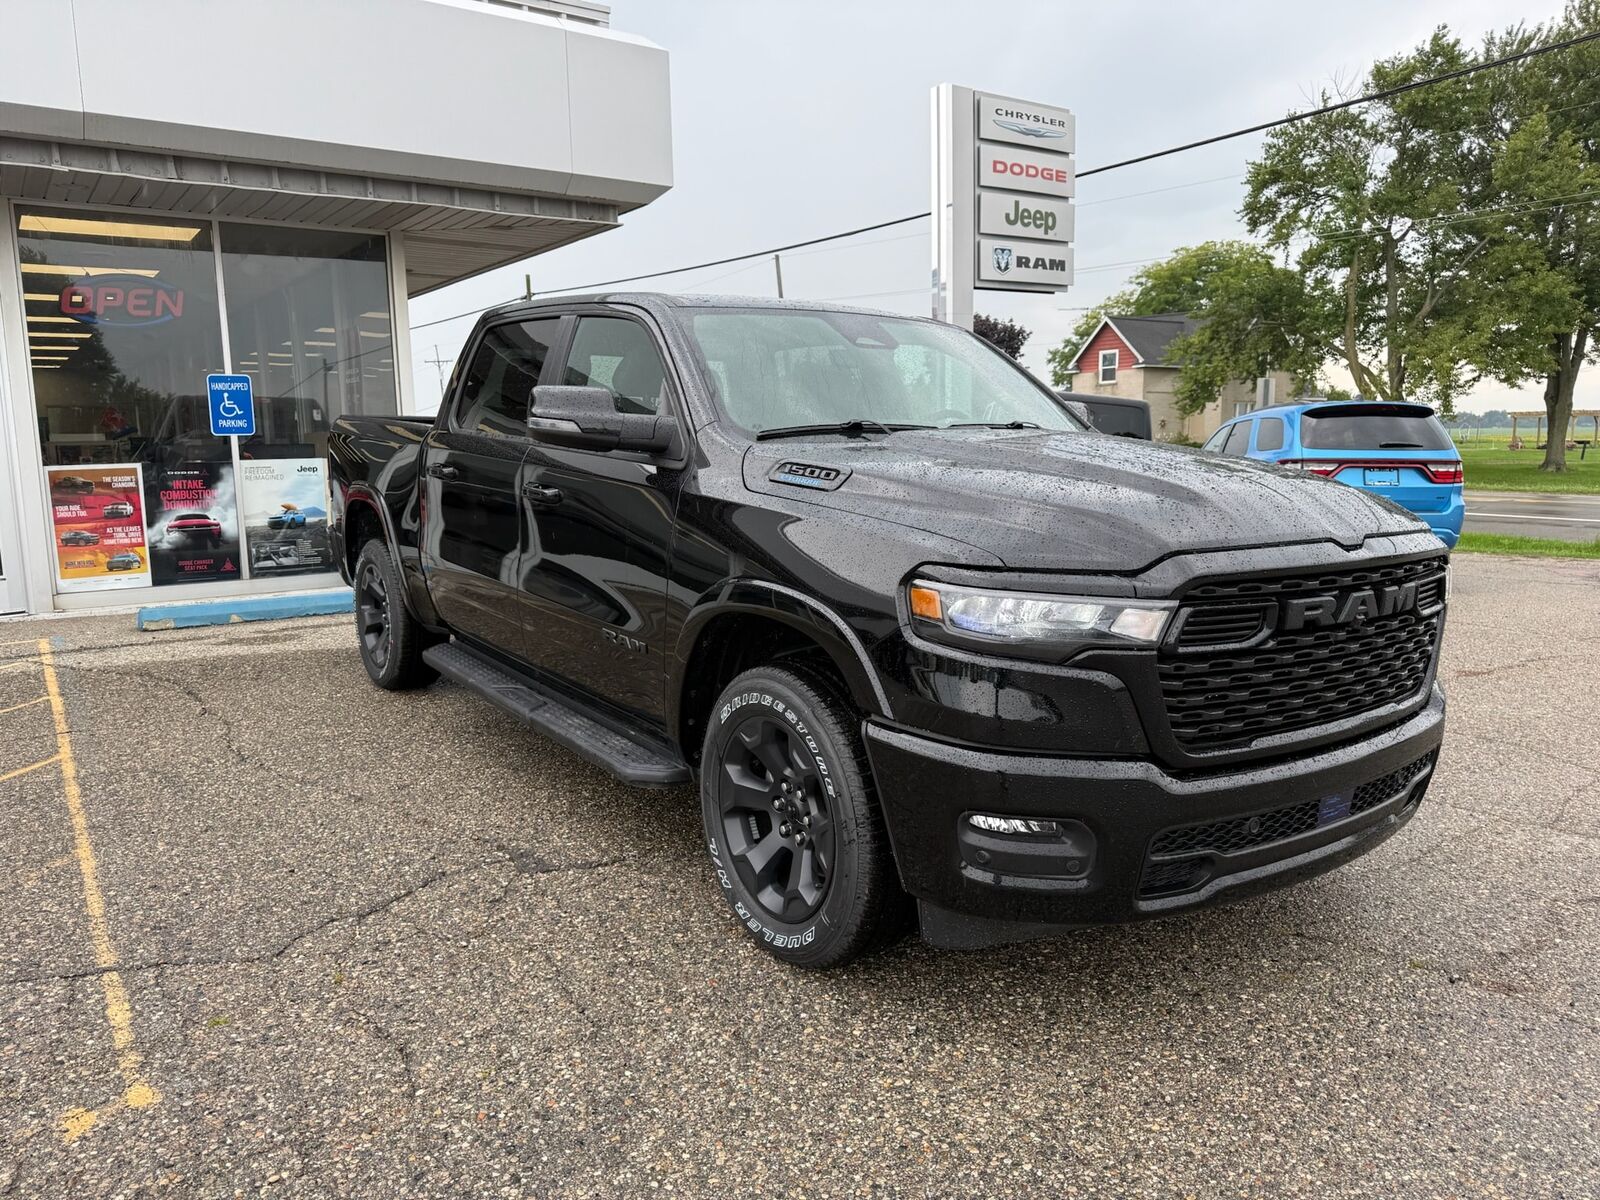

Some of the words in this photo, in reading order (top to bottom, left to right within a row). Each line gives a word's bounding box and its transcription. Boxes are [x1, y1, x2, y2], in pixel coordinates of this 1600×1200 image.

[995, 107, 1066, 128] CHRYSLER
[992, 160, 1067, 183] DODGE
[1005, 200, 1057, 235] Jeep
[1016, 255, 1066, 272] RAM
[61, 286, 184, 317] OPEN
[211, 382, 249, 391] HANDICAPPED
[218, 419, 248, 428] PARKING
[297, 465, 318, 473] Jeep
[780, 464, 837, 480] 1500
[172, 479, 206, 489] INTAKE.
[1284, 582, 1416, 631] RAM
[601, 627, 649, 655] RAM
[720, 692, 836, 799] BRIDGESTONE
[735, 901, 816, 949] DUELER
